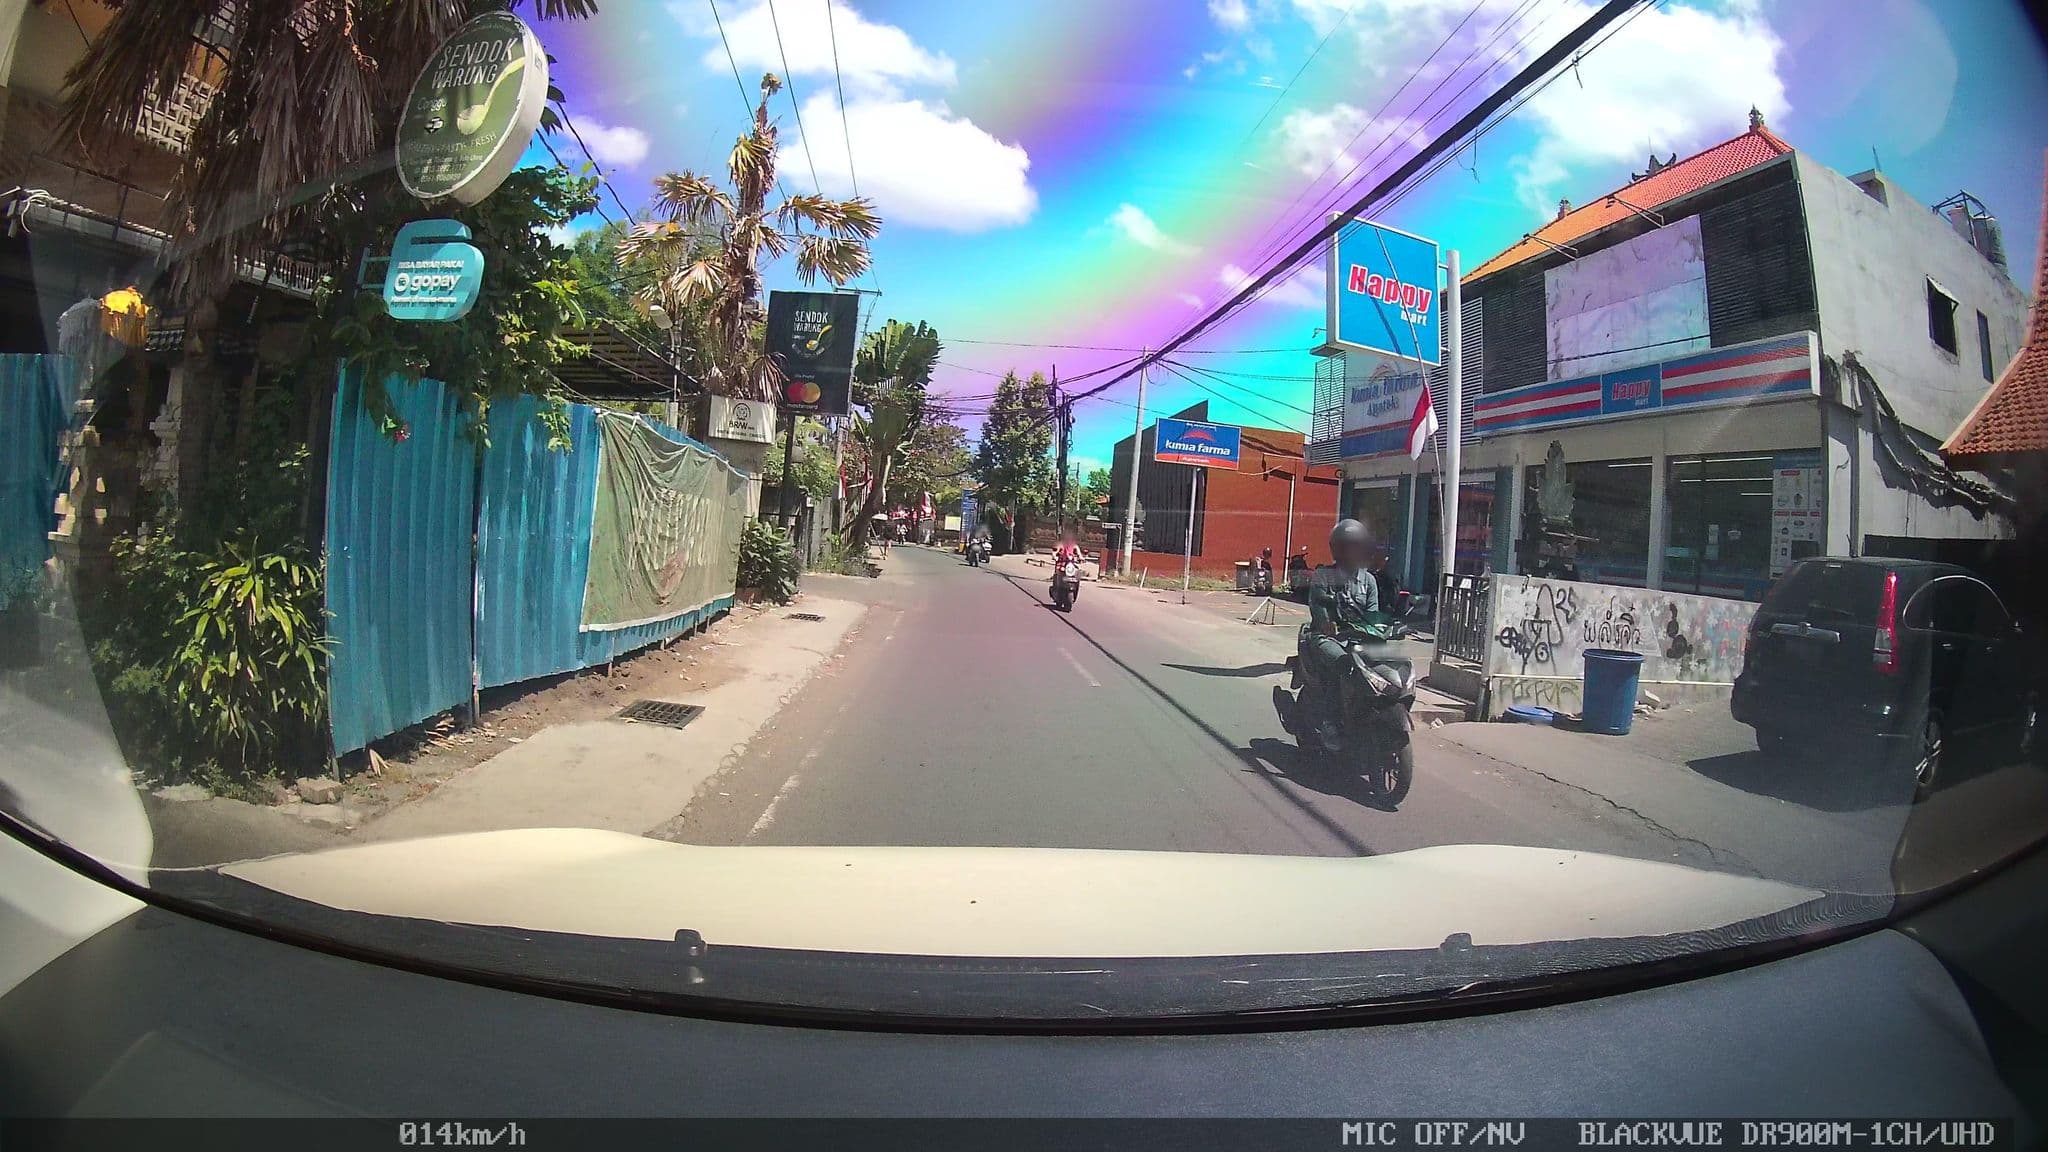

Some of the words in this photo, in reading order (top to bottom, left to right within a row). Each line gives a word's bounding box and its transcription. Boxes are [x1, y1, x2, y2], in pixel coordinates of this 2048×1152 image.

[439, 38, 518, 69] SENDOK
[432, 64, 498, 89] WARUNG
[410, 275, 462, 291] gopay
[1348, 264, 1432, 313] Happy
[795, 311, 828, 323] SENDOK
[1401, 310, 1427, 326] mart
[794, 322, 822, 332] WARUNG
[1612, 380, 1651, 400] Happy
[1166, 440, 1195, 452] kimia
[1198, 443, 1231, 456] farma
